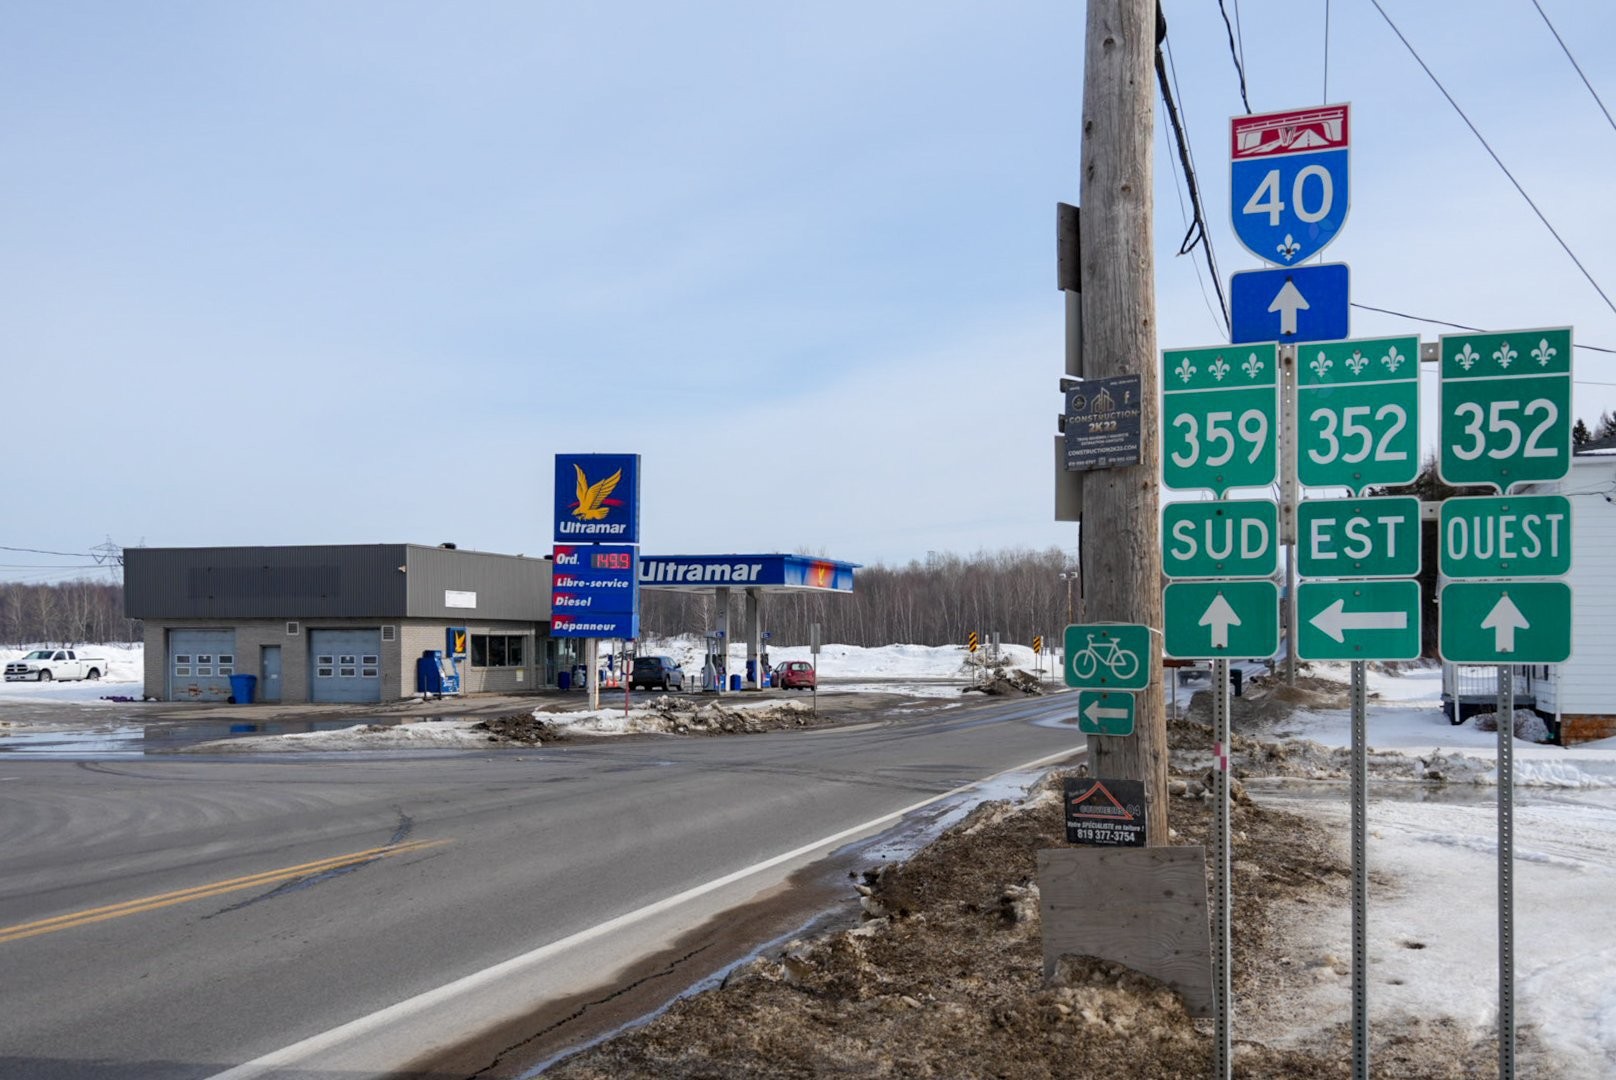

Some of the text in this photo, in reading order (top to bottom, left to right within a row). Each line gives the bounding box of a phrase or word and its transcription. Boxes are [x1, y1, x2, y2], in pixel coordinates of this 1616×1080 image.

[1242, 164, 1334, 227] 40
[1170, 407, 1269, 468] 359
[1308, 403, 1408, 465] 352
[1451, 398, 1559, 461] 352
[559, 521, 626, 534] Ultramar
[1170, 517, 1269, 562] SUD
[1310, 515, 1406, 560] EST
[1447, 513, 1565, 559] OUEST
[556, 553, 580, 565] Ord.
[639, 561, 762, 582] Ultramar
[557, 578, 629, 588] Libre-service
[555, 596, 592, 607] Diesel
[554, 620, 616, 632] Dépanneur
[1077, 829, 1136, 842] 819 377-3754
